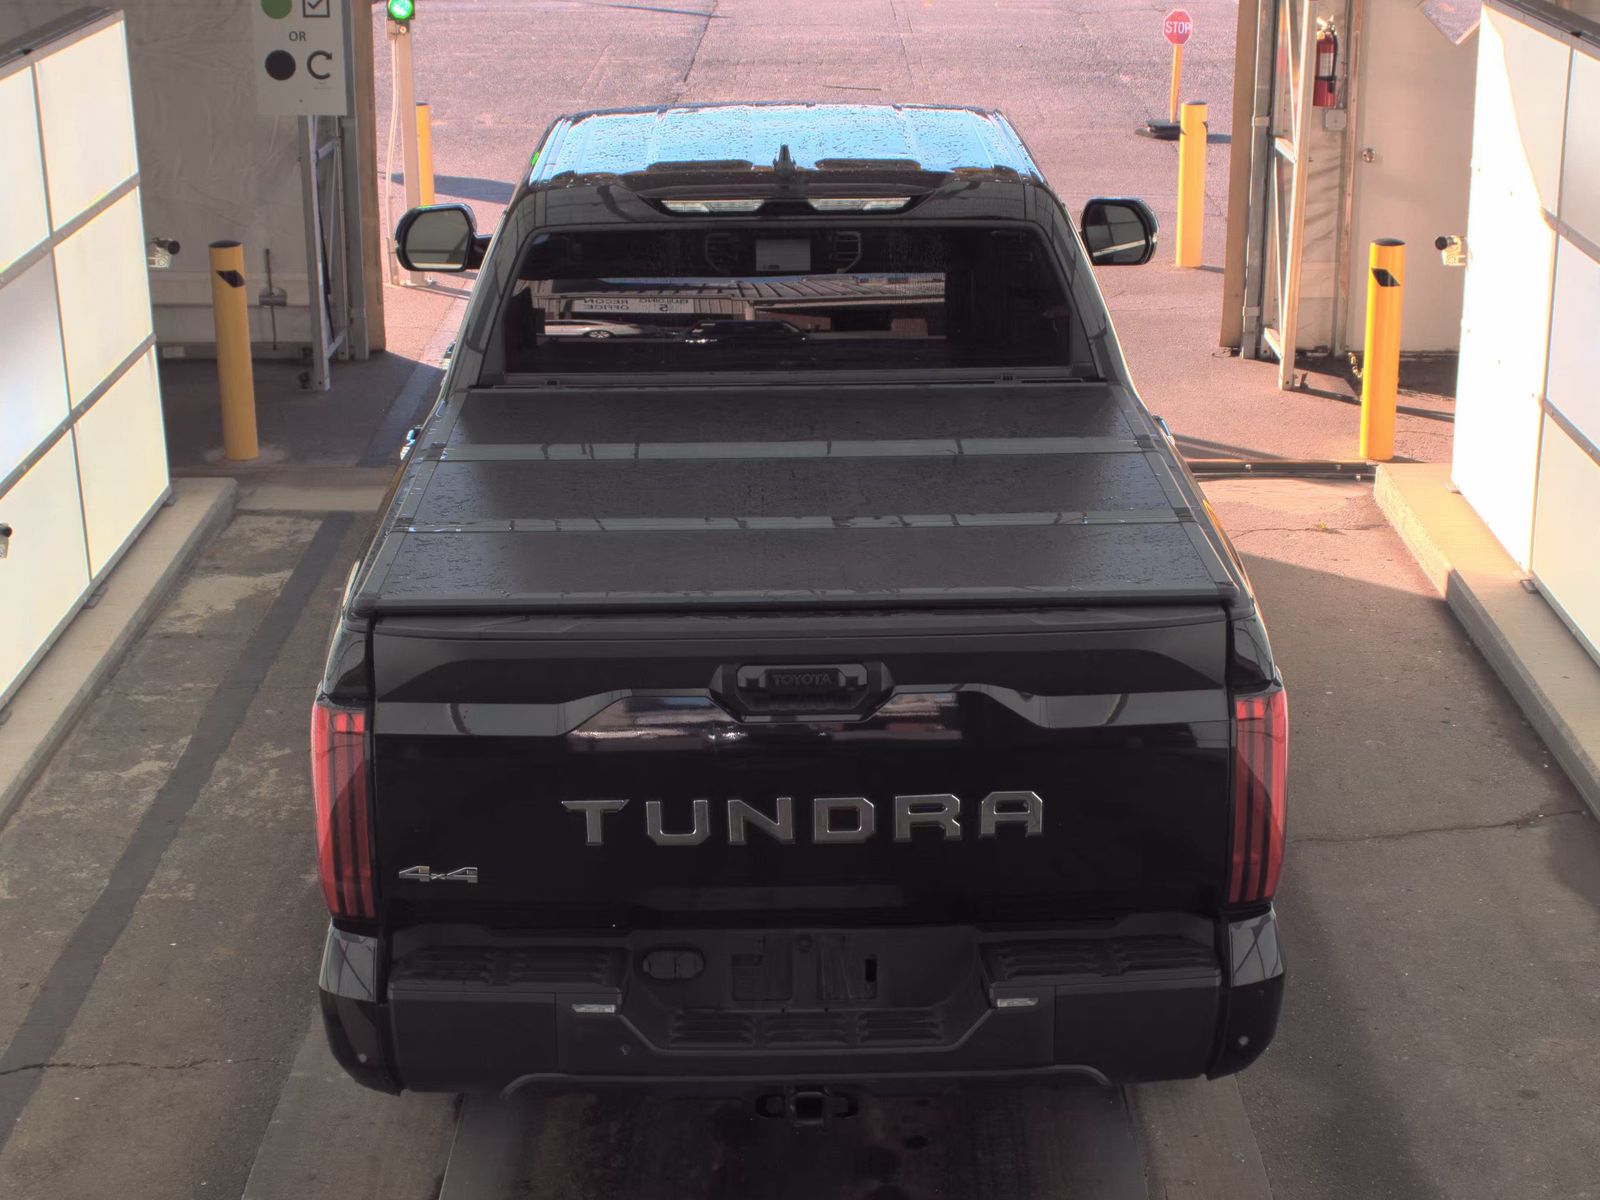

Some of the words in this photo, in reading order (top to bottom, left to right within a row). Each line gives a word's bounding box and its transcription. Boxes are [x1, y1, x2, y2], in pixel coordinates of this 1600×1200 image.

[1165, 20, 1191, 34] STOP
[288, 30, 307, 42] OR
[773, 673, 833, 686] TOYOTA
[561, 791, 1044, 846] TUNDRA
